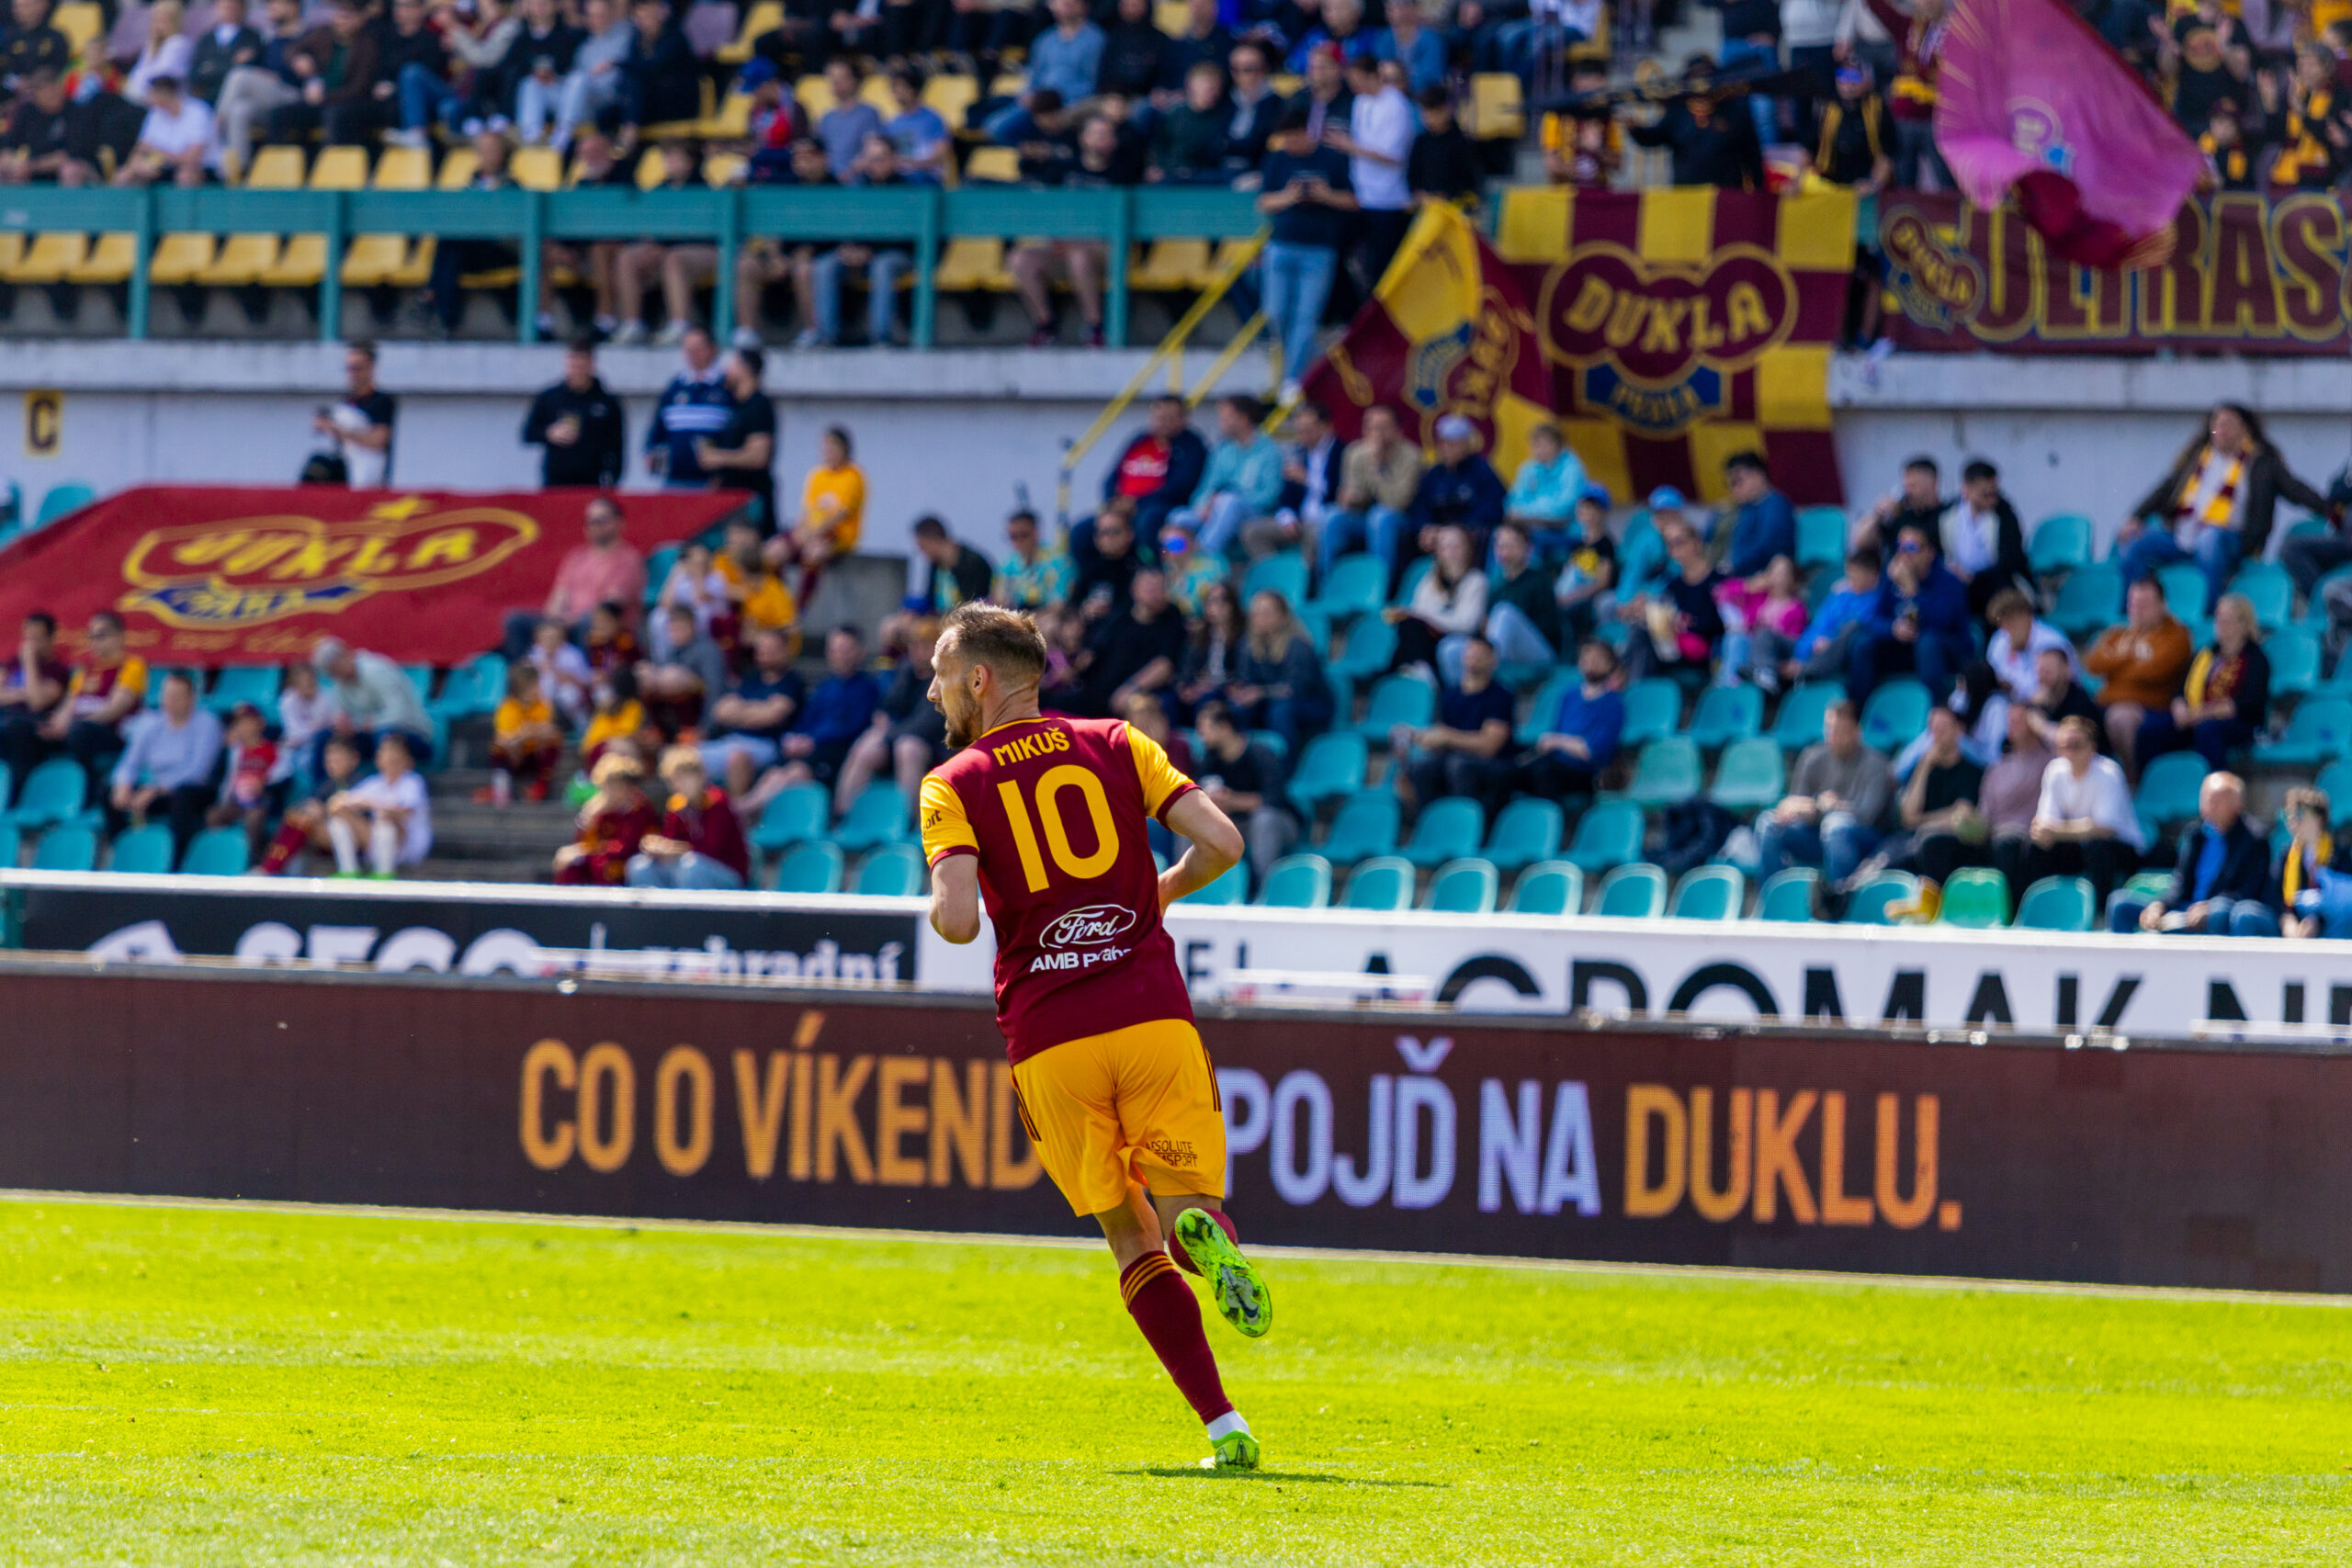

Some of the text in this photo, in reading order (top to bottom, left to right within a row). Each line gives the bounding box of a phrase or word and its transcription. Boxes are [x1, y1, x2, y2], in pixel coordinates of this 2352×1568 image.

[1565, 273, 1773, 354] DUKLA
[30, 398, 57, 449] C
[992, 727, 1070, 766] MIKUŠ
[997, 764, 1119, 893] 10
[1055, 910, 1119, 943] Ford
[1030, 952, 1080, 973] AMB
[519, 1011, 1963, 1232] CO O VÍKEND POJĎ NA DUKLU.
